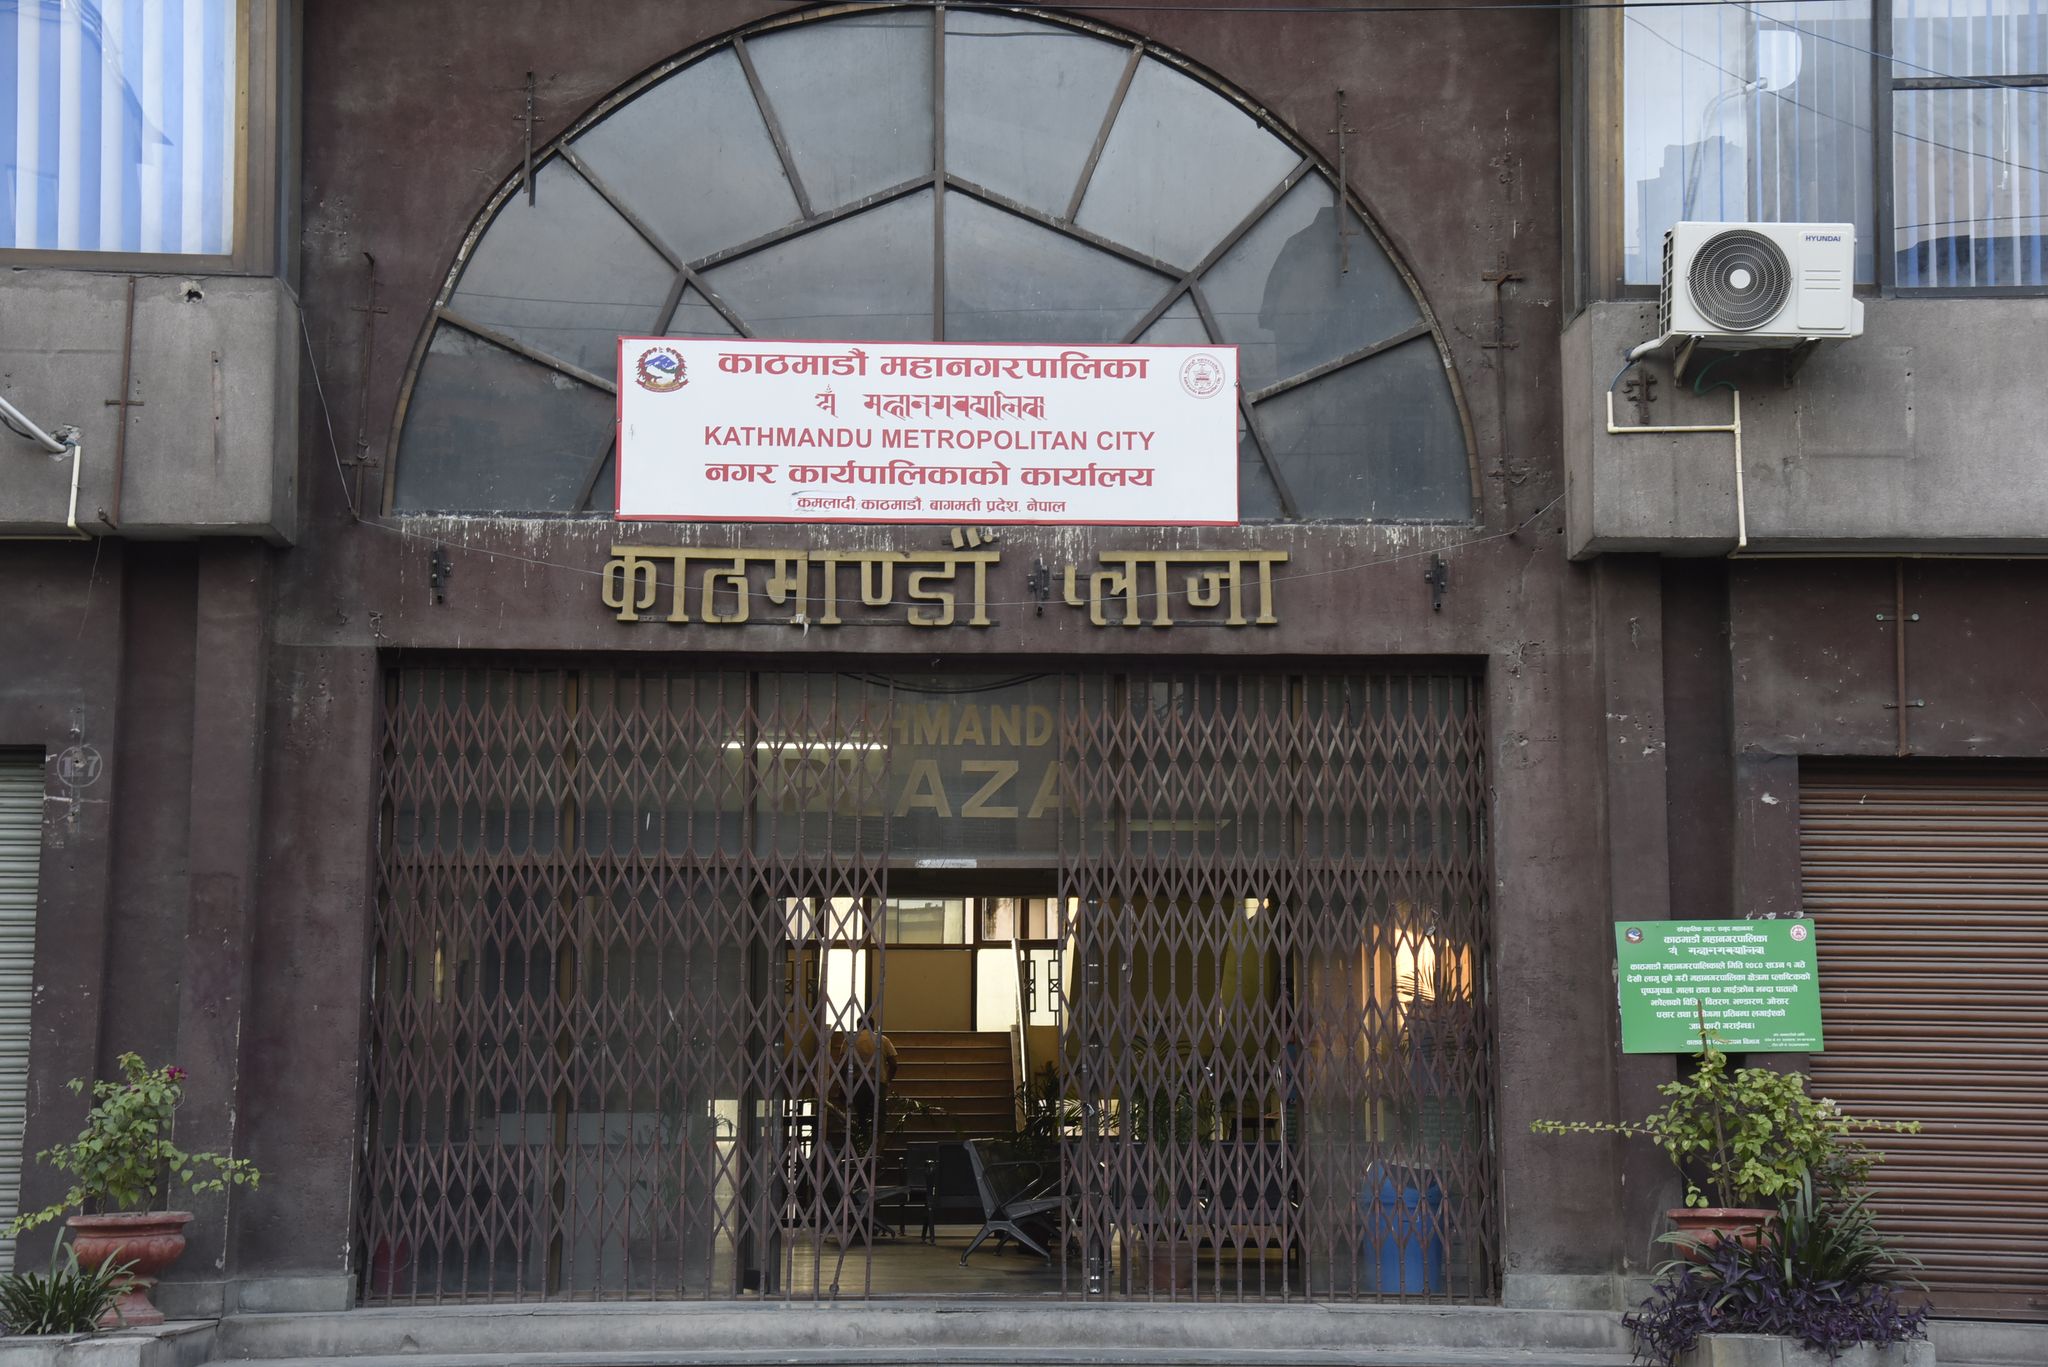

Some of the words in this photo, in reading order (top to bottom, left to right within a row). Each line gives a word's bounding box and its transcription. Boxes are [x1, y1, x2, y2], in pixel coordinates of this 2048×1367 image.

[880, 350, 1149, 380] महानगरपालिका
[704, 426, 872, 449] KATHMANDU
[882, 428, 1087, 450] METROPOLITAN
[1096, 430, 1155, 451] CITY
[704, 463, 779, 484] नगर
[788, 459, 1010, 487] कार्यपालिकाको
[1020, 461, 1154, 488] कार्यालय
[929, 496, 982, 512] बागमती
[1027, 497, 1066, 513] नेपाल
[1064, 551, 1288, 625] प्लाजा
[1702, 933, 1768, 943] महानगरपालिका
[1727, 960, 1744, 969] मिति
[1690, 972, 1746, 982] महानगरपालिका
